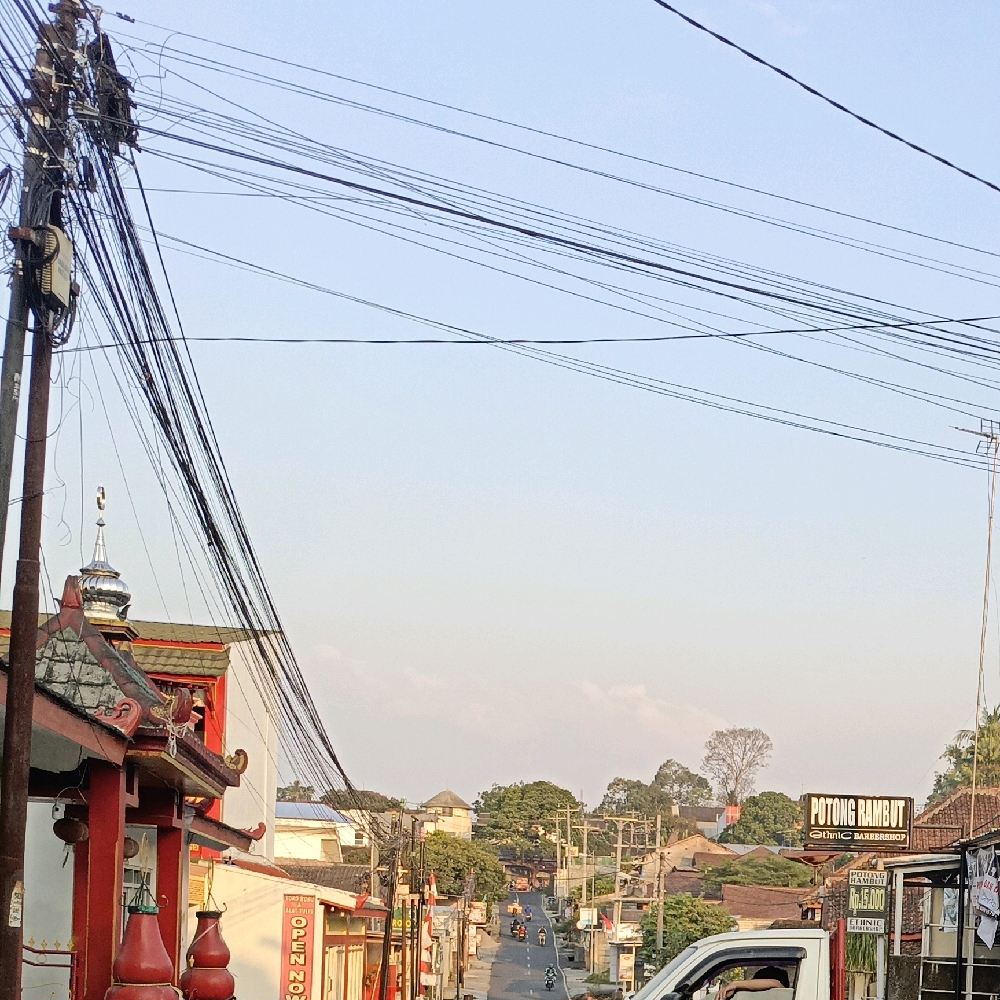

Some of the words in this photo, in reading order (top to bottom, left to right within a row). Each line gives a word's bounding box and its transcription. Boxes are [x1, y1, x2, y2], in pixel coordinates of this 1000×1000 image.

[810, 797, 855, 826] POTONG
[858, 799, 905, 828] RAMBUT
[853, 832, 906, 841] BARBERSHOP
[849, 918, 883, 926] ETHNIC
[290, 916, 308, 966] OPEN
